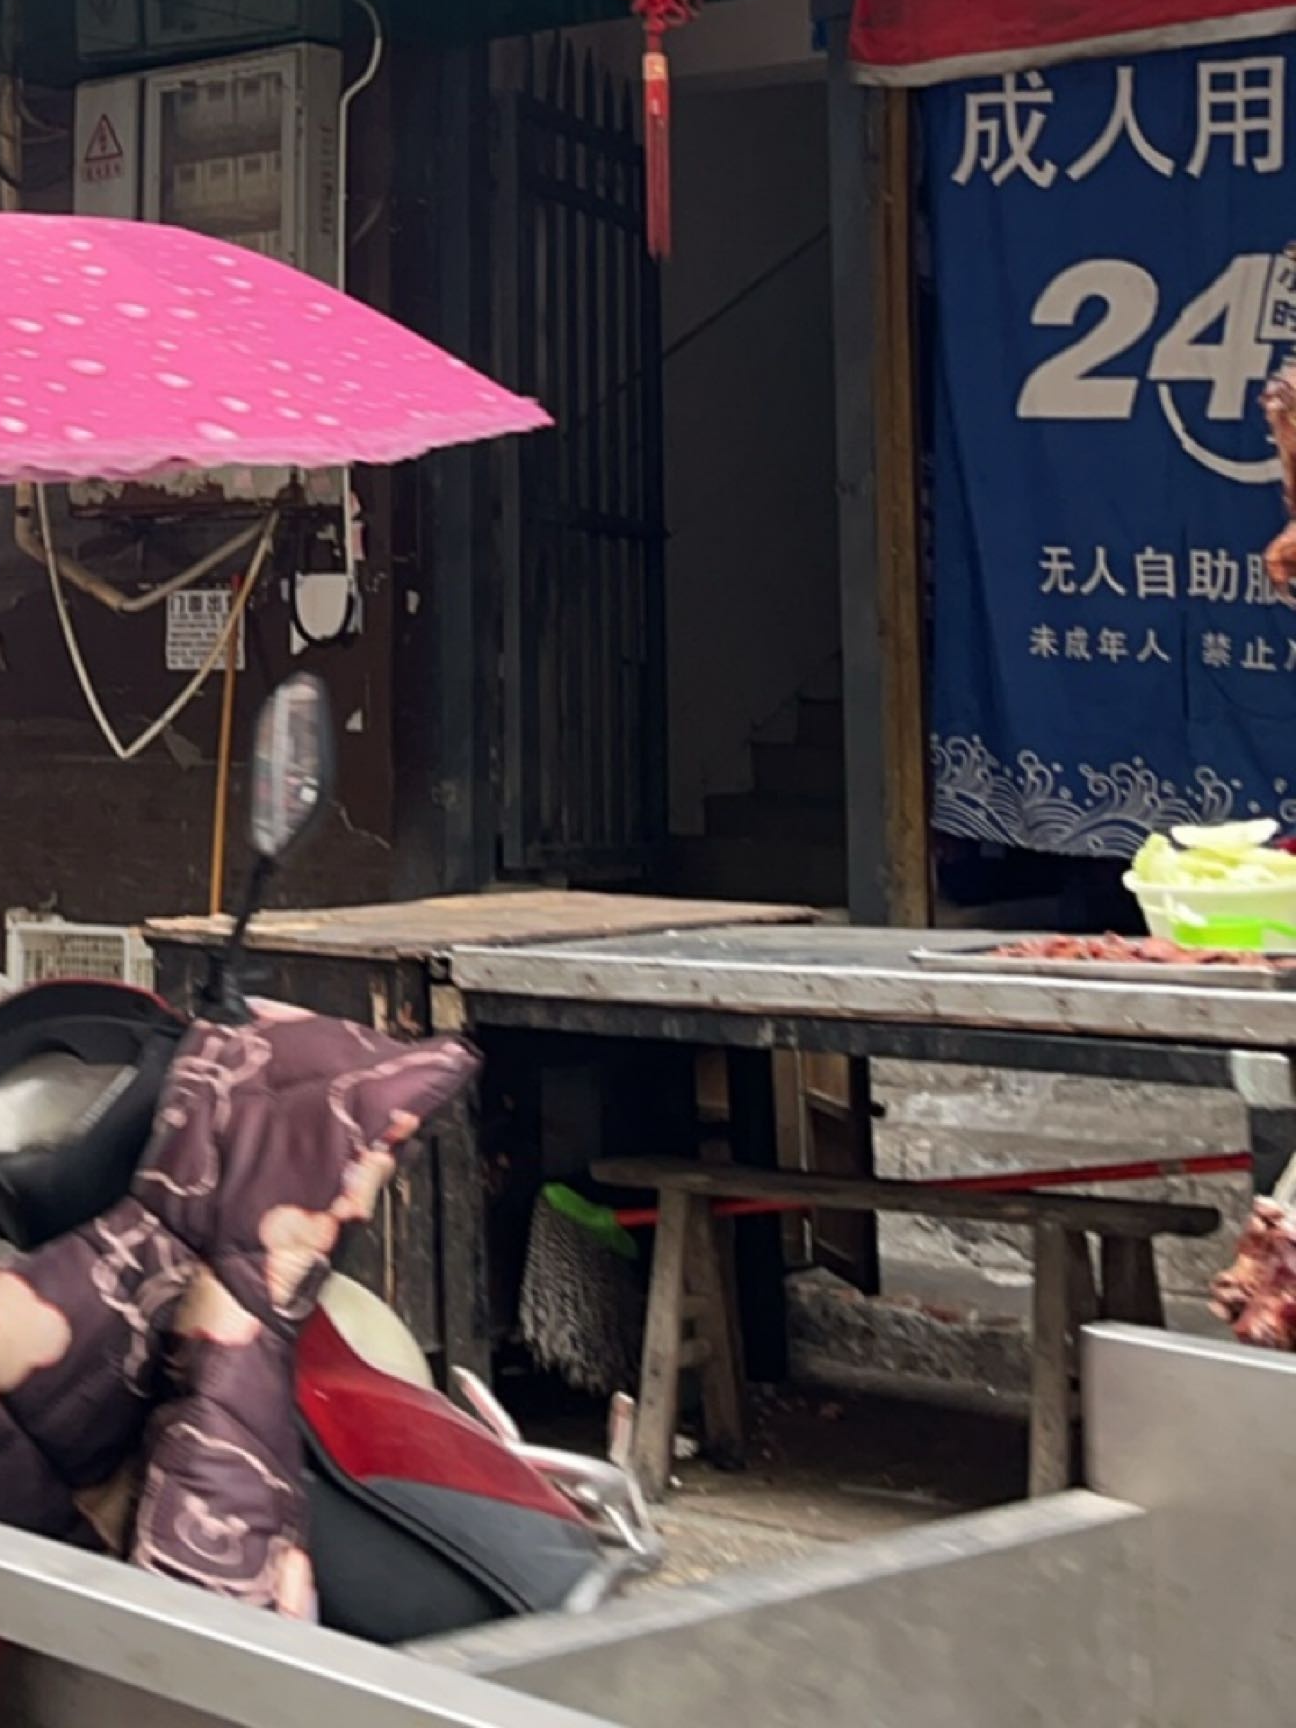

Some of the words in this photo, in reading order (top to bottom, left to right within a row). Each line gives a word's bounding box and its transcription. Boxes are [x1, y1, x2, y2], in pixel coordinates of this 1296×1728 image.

[950, 56, 1286, 188] 成人用
[1016, 254, 1275, 420] 24
[1028, 622, 1173, 665] 未成年人
